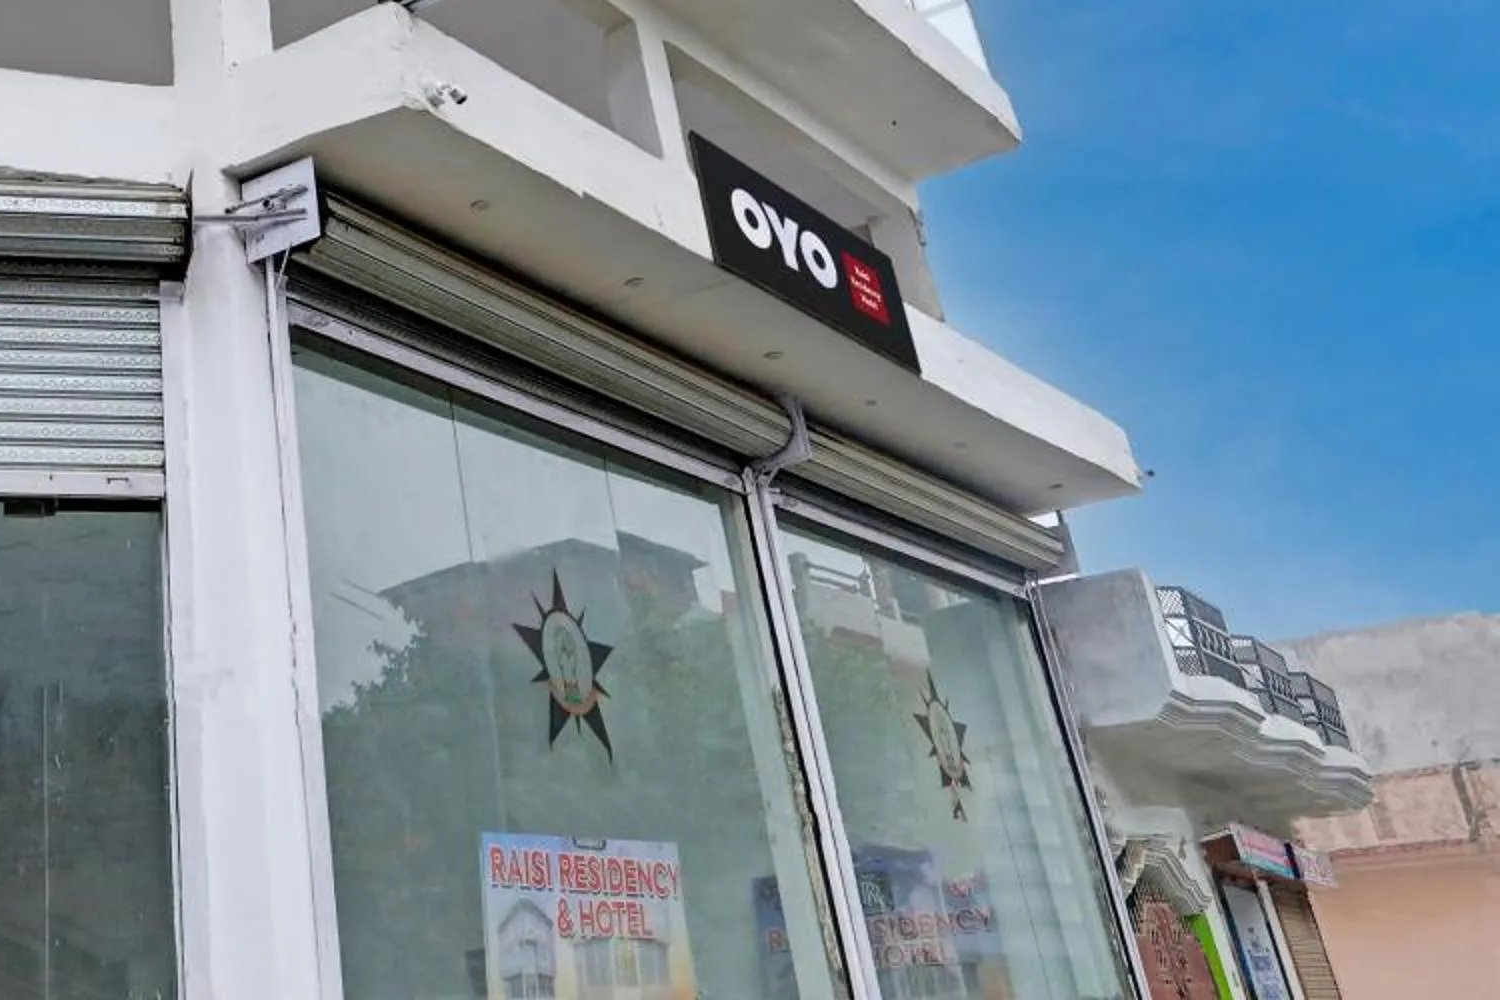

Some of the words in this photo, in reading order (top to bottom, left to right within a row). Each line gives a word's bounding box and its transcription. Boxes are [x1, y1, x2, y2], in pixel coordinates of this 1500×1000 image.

[731, 187, 839, 290] OYO
[490, 845, 553, 889] RAISI
[558, 851, 680, 899] RESIDENCY
[557, 897, 575, 938] &
[579, 899, 653, 938] HOTEL
